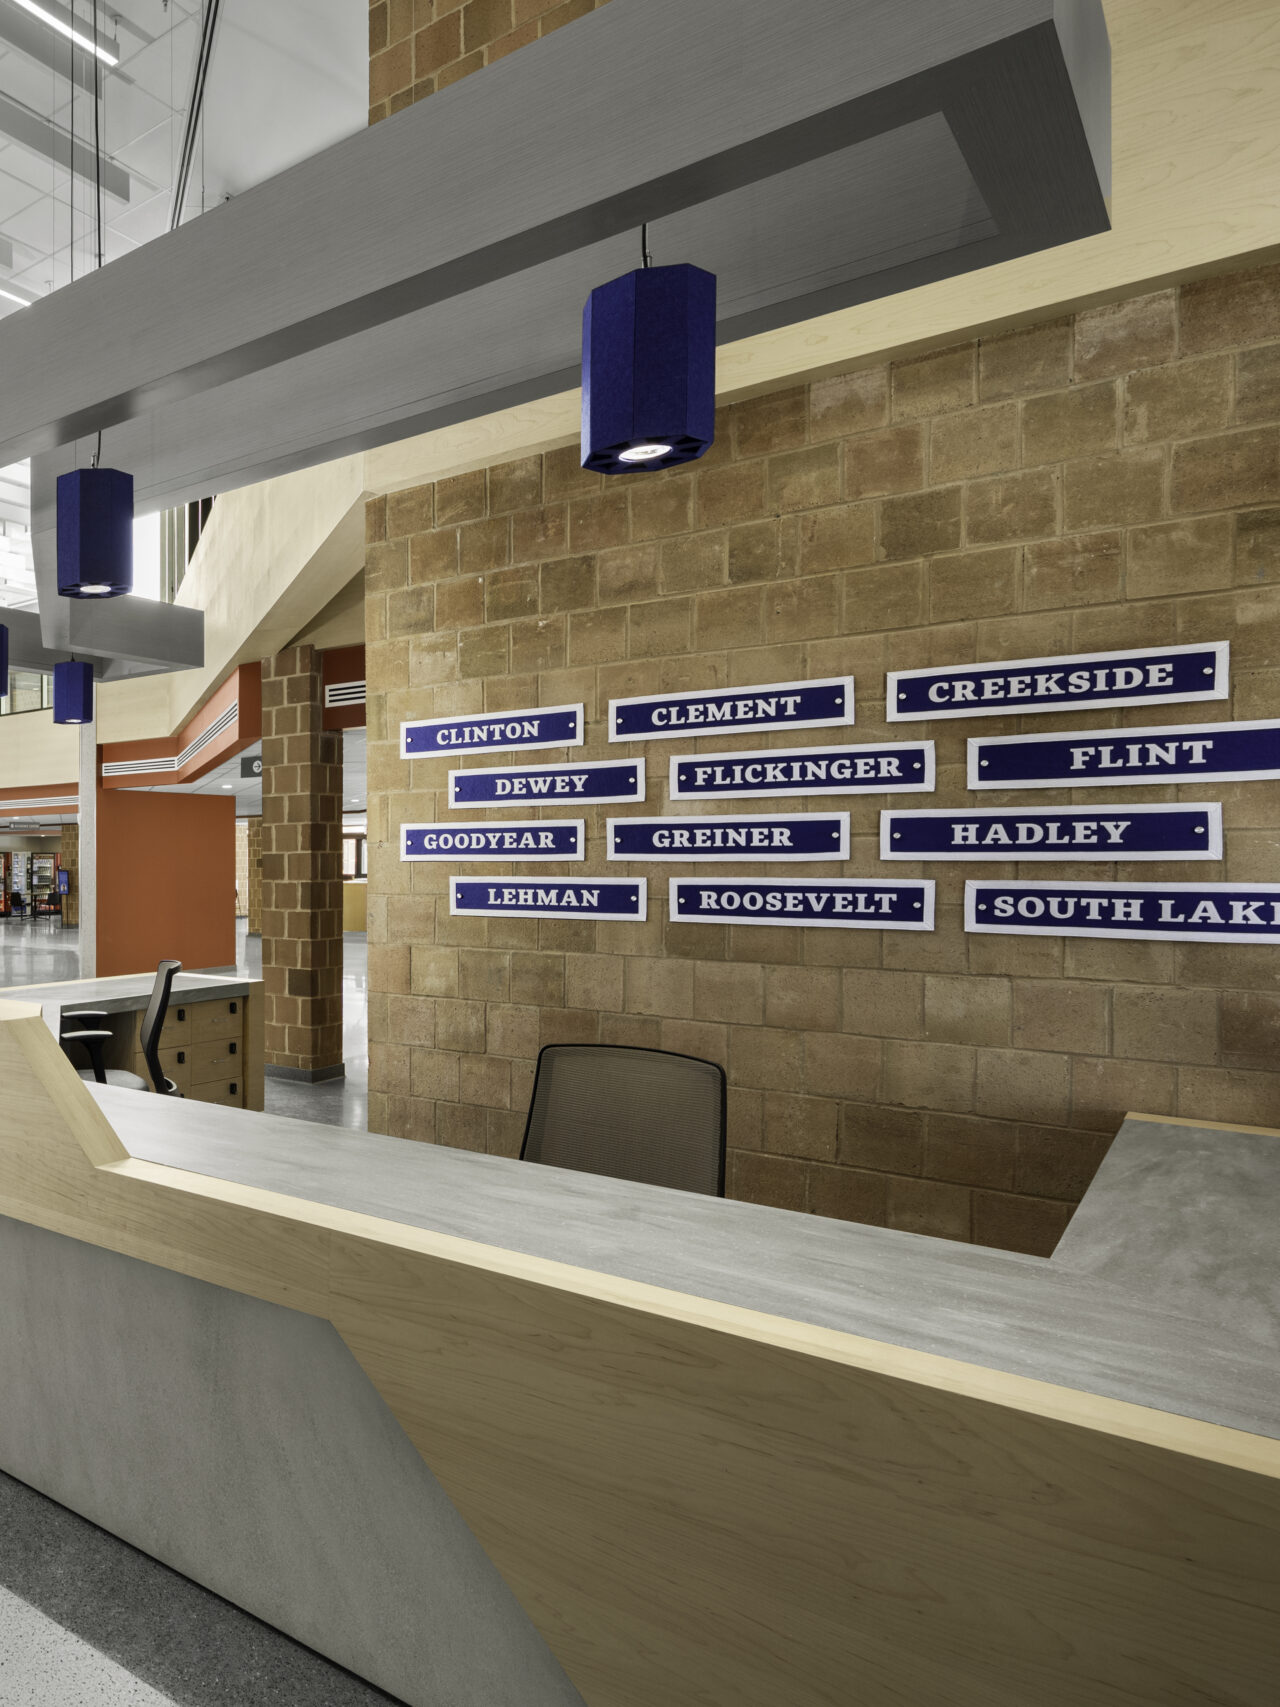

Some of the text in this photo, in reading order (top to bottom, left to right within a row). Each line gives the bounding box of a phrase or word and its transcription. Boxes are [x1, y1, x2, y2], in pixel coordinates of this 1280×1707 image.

[928, 663, 1174, 703] CREEKSIDE
[651, 695, 801, 727] CLEMENT
[436, 720, 541, 746] CLINTON
[1069, 740, 1213, 770] FLINT
[694, 757, 903, 786] FLICKINGER
[494, 774, 589, 796] DEWEY
[423, 831, 556, 850] GOODYEAR
[652, 827, 794, 848] GREINER
[951, 821, 1131, 845] HADLEY
[487, 888, 601, 907] LEHMAN
[699, 891, 897, 913] ROOSEVELT
[993, 895, 1144, 922] SOUTH
